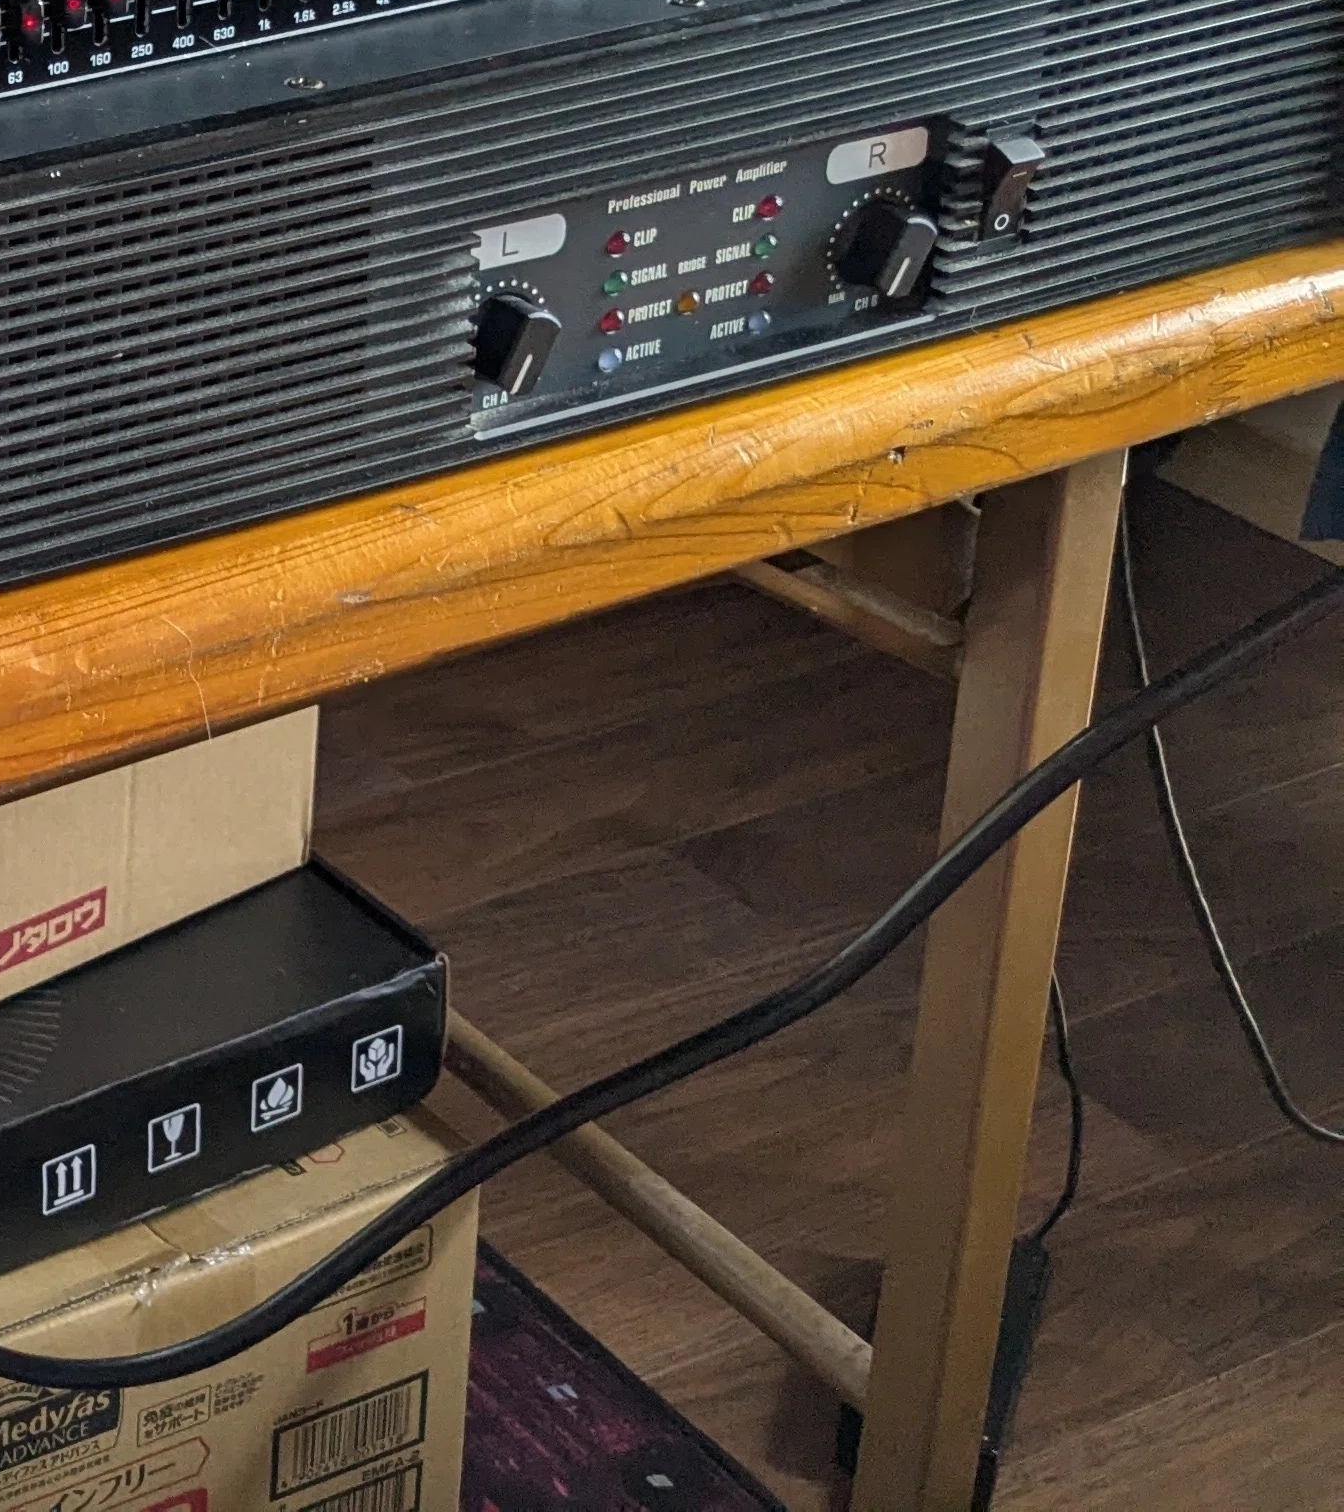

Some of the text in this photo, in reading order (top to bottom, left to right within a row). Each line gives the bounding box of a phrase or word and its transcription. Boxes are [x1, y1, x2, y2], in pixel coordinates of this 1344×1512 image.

[8, 71, 23, 85] 63
[47, 61, 69, 75] 100
[90, 52, 111, 66] 160
[131, 43, 153, 57] 250
[173, 35, 194, 49] 400
[213, 26, 235, 40] 630
[258, 19, 271, 32] 1k
[293, 9, 315, 24] 1.6k
[332, 1, 355, 15] 2.5k
[868, 140, 888, 167] R
[608, 160, 788, 215] Professional Power Amplifier
[732, 202, 755, 223] CLIP
[502, 231, 519, 257] L
[633, 227, 657, 249] CLIP
[631, 263, 668, 286] SIGNAL
[715, 243, 752, 265] SIGNAL
[627, 279, 748, 325] PROTECT PROTECT
[710, 318, 746, 340] ACTIVE
[625, 338, 661, 363] ACTIVE
[482, 393, 498, 409] CH
[0, 1421, 89, 1468] ADVANCE
